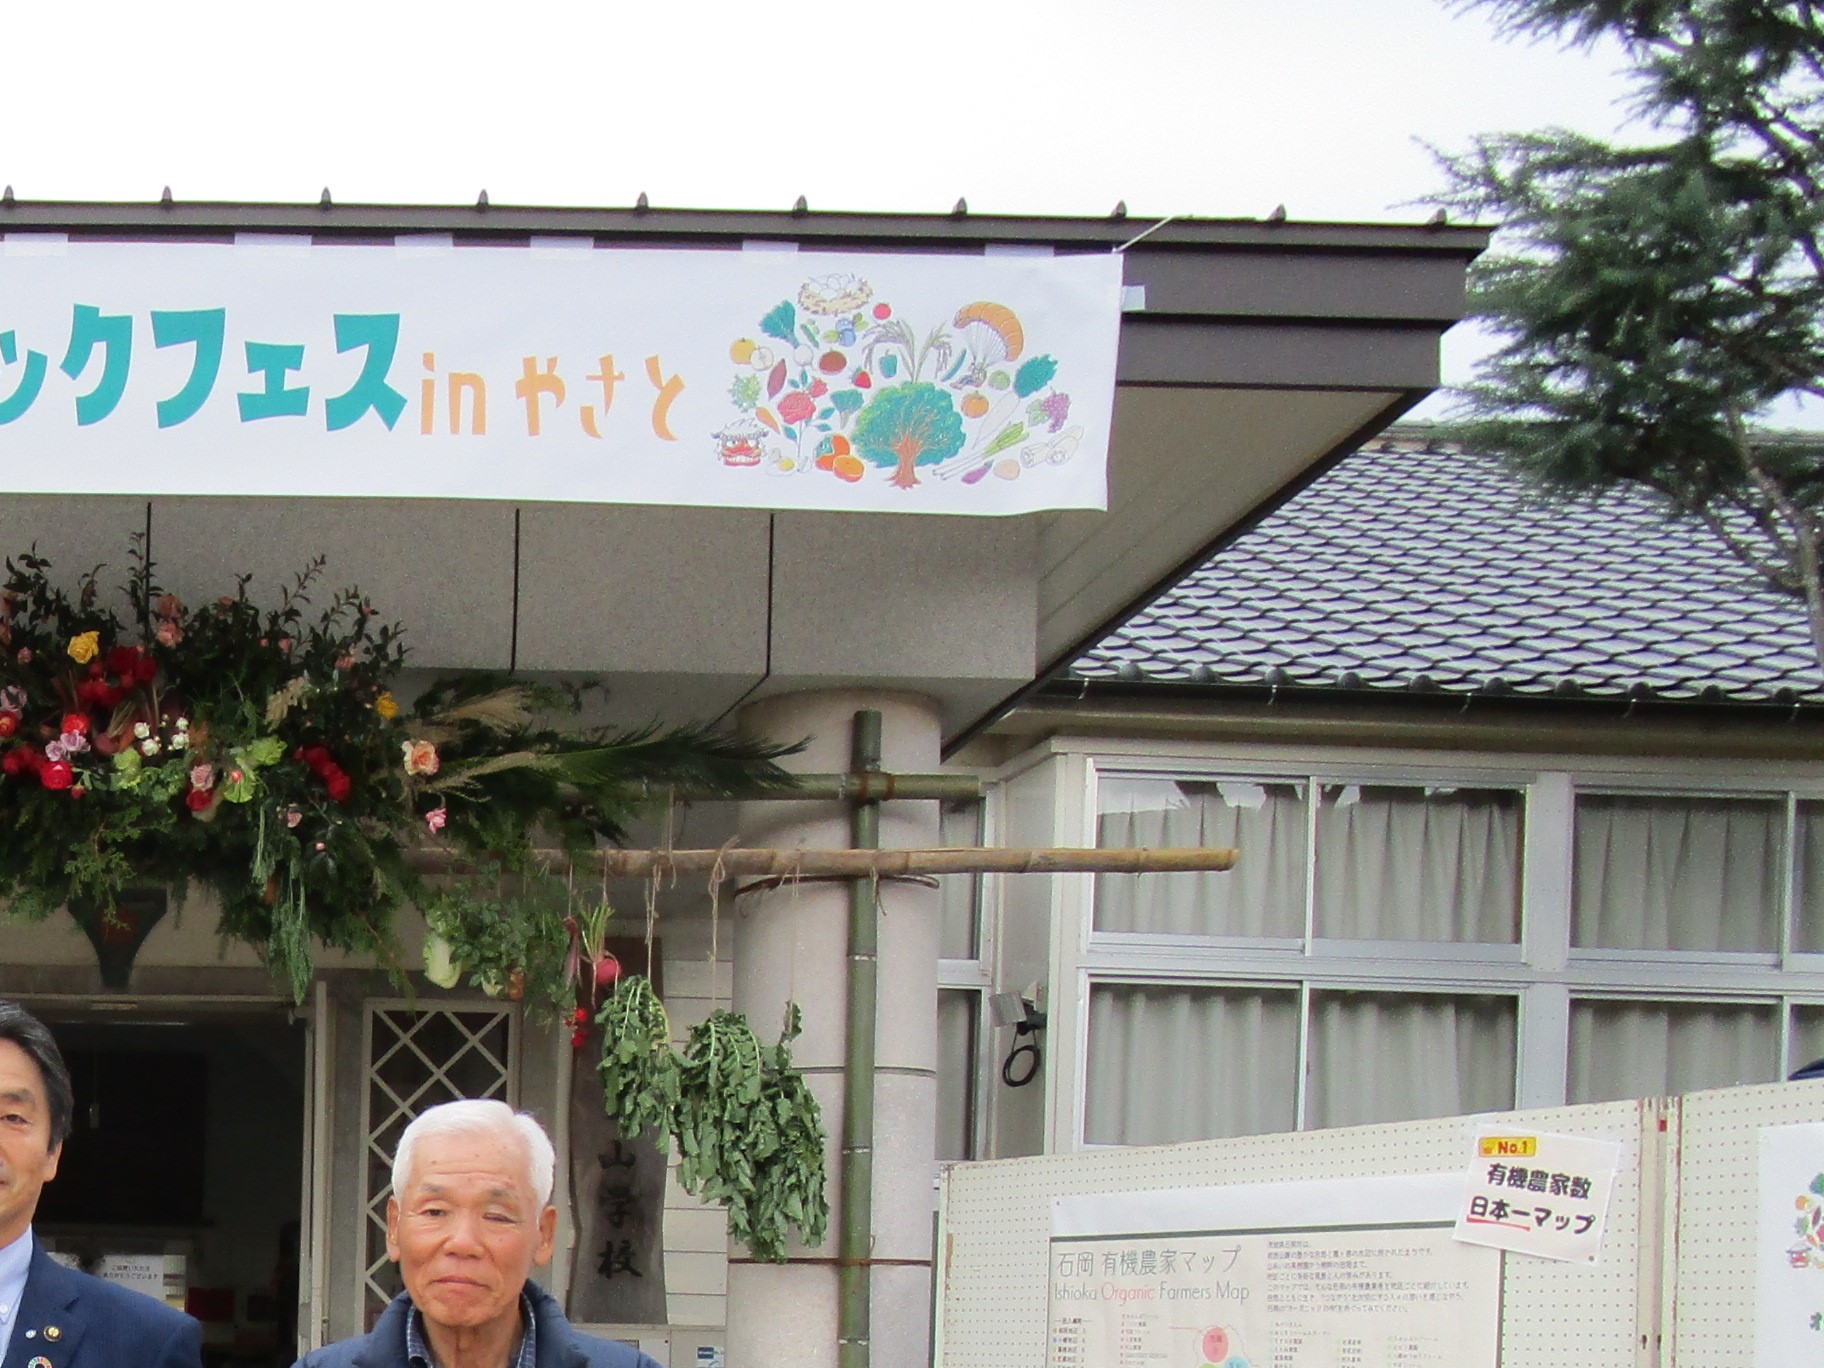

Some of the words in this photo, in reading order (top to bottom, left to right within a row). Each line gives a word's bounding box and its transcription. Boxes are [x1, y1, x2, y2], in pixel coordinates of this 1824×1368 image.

[419, 352, 487, 436] in
[514, 353, 687, 441] やさと
[1497, 1140, 1528, 1154] No.1
[1487, 1163, 1592, 1200] 有機農家数
[1470, 1195, 1596, 1234] 日本一マップ
[1056, 1251, 1094, 1278] 石岡
[1101, 1244, 1242, 1277] 有機農家マップ
[1054, 1283, 1097, 1301] Ishioka
[1101, 1281, 1155, 1307] Organic
[1159, 1280, 1211, 1301] Farmers
[1216, 1281, 1250, 1305] Map
